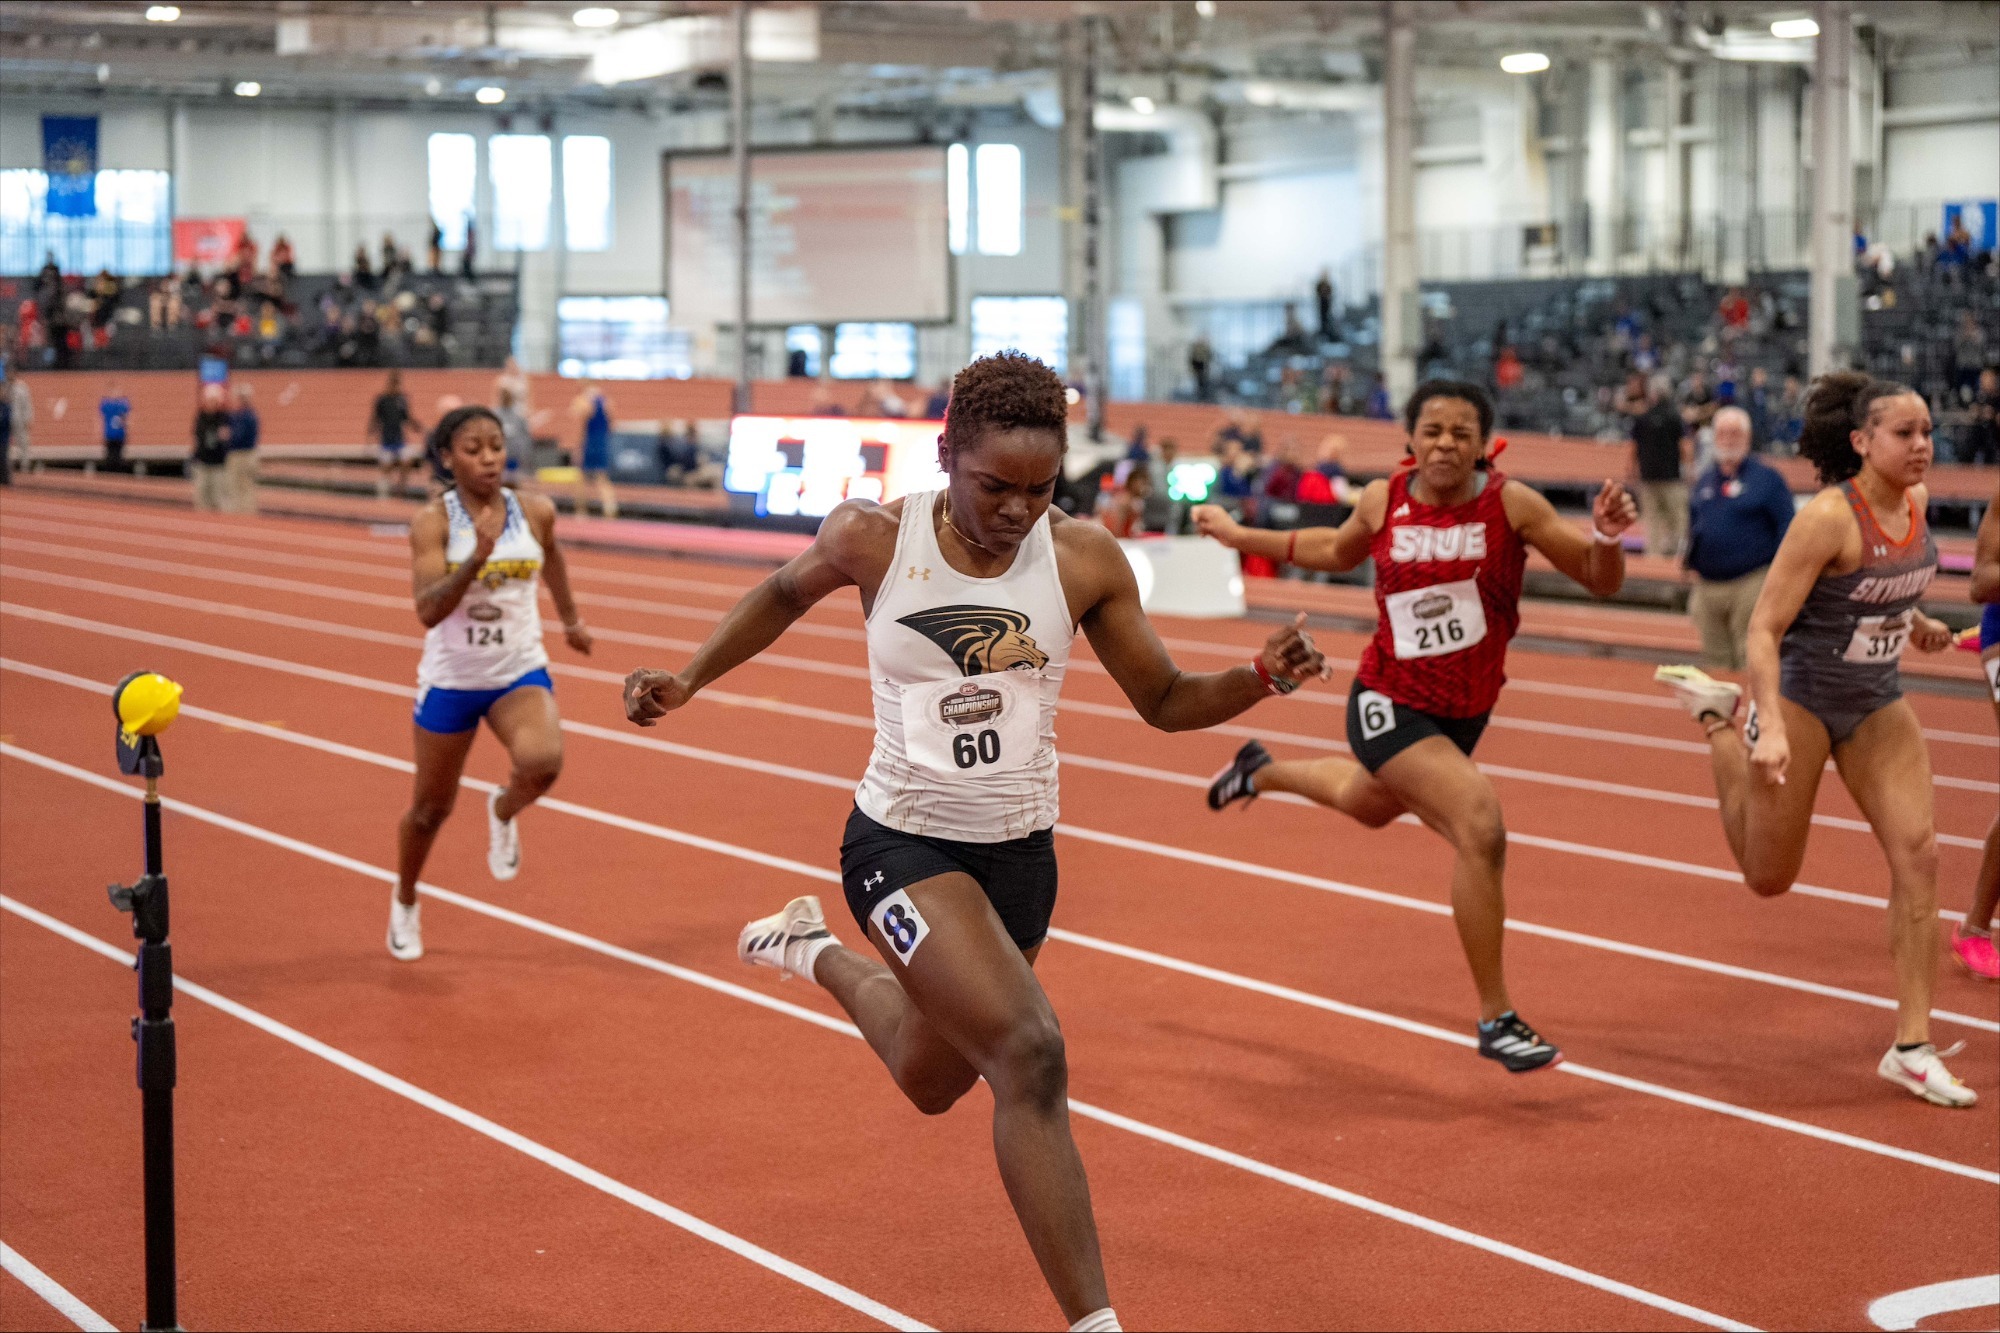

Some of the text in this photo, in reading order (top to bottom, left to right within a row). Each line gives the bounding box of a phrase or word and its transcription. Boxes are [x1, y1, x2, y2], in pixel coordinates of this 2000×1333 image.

[1389, 522, 1487, 562] SIUE
[466, 627, 504, 645] 124
[1415, 619, 1464, 649] 216
[943, 698, 999, 715] CHAMPIONSHIP
[1364, 701, 1386, 731] 6
[952, 729, 1001, 769] 60
[883, 904, 917, 954] 8
